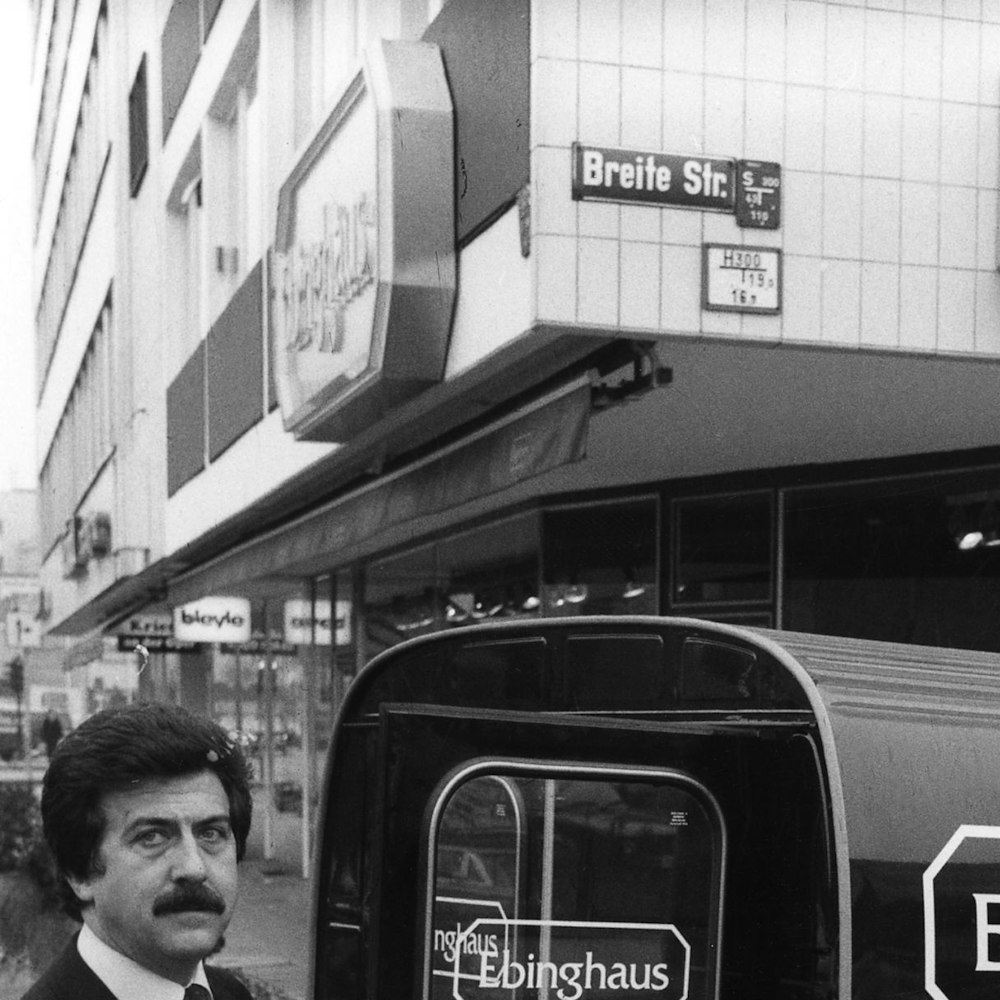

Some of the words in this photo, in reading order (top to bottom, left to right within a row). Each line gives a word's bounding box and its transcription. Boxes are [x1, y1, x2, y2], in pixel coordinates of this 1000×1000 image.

[583, 151, 671, 191] Breite
[683, 160, 727, 198] Str.
[742, 170, 754, 187] S
